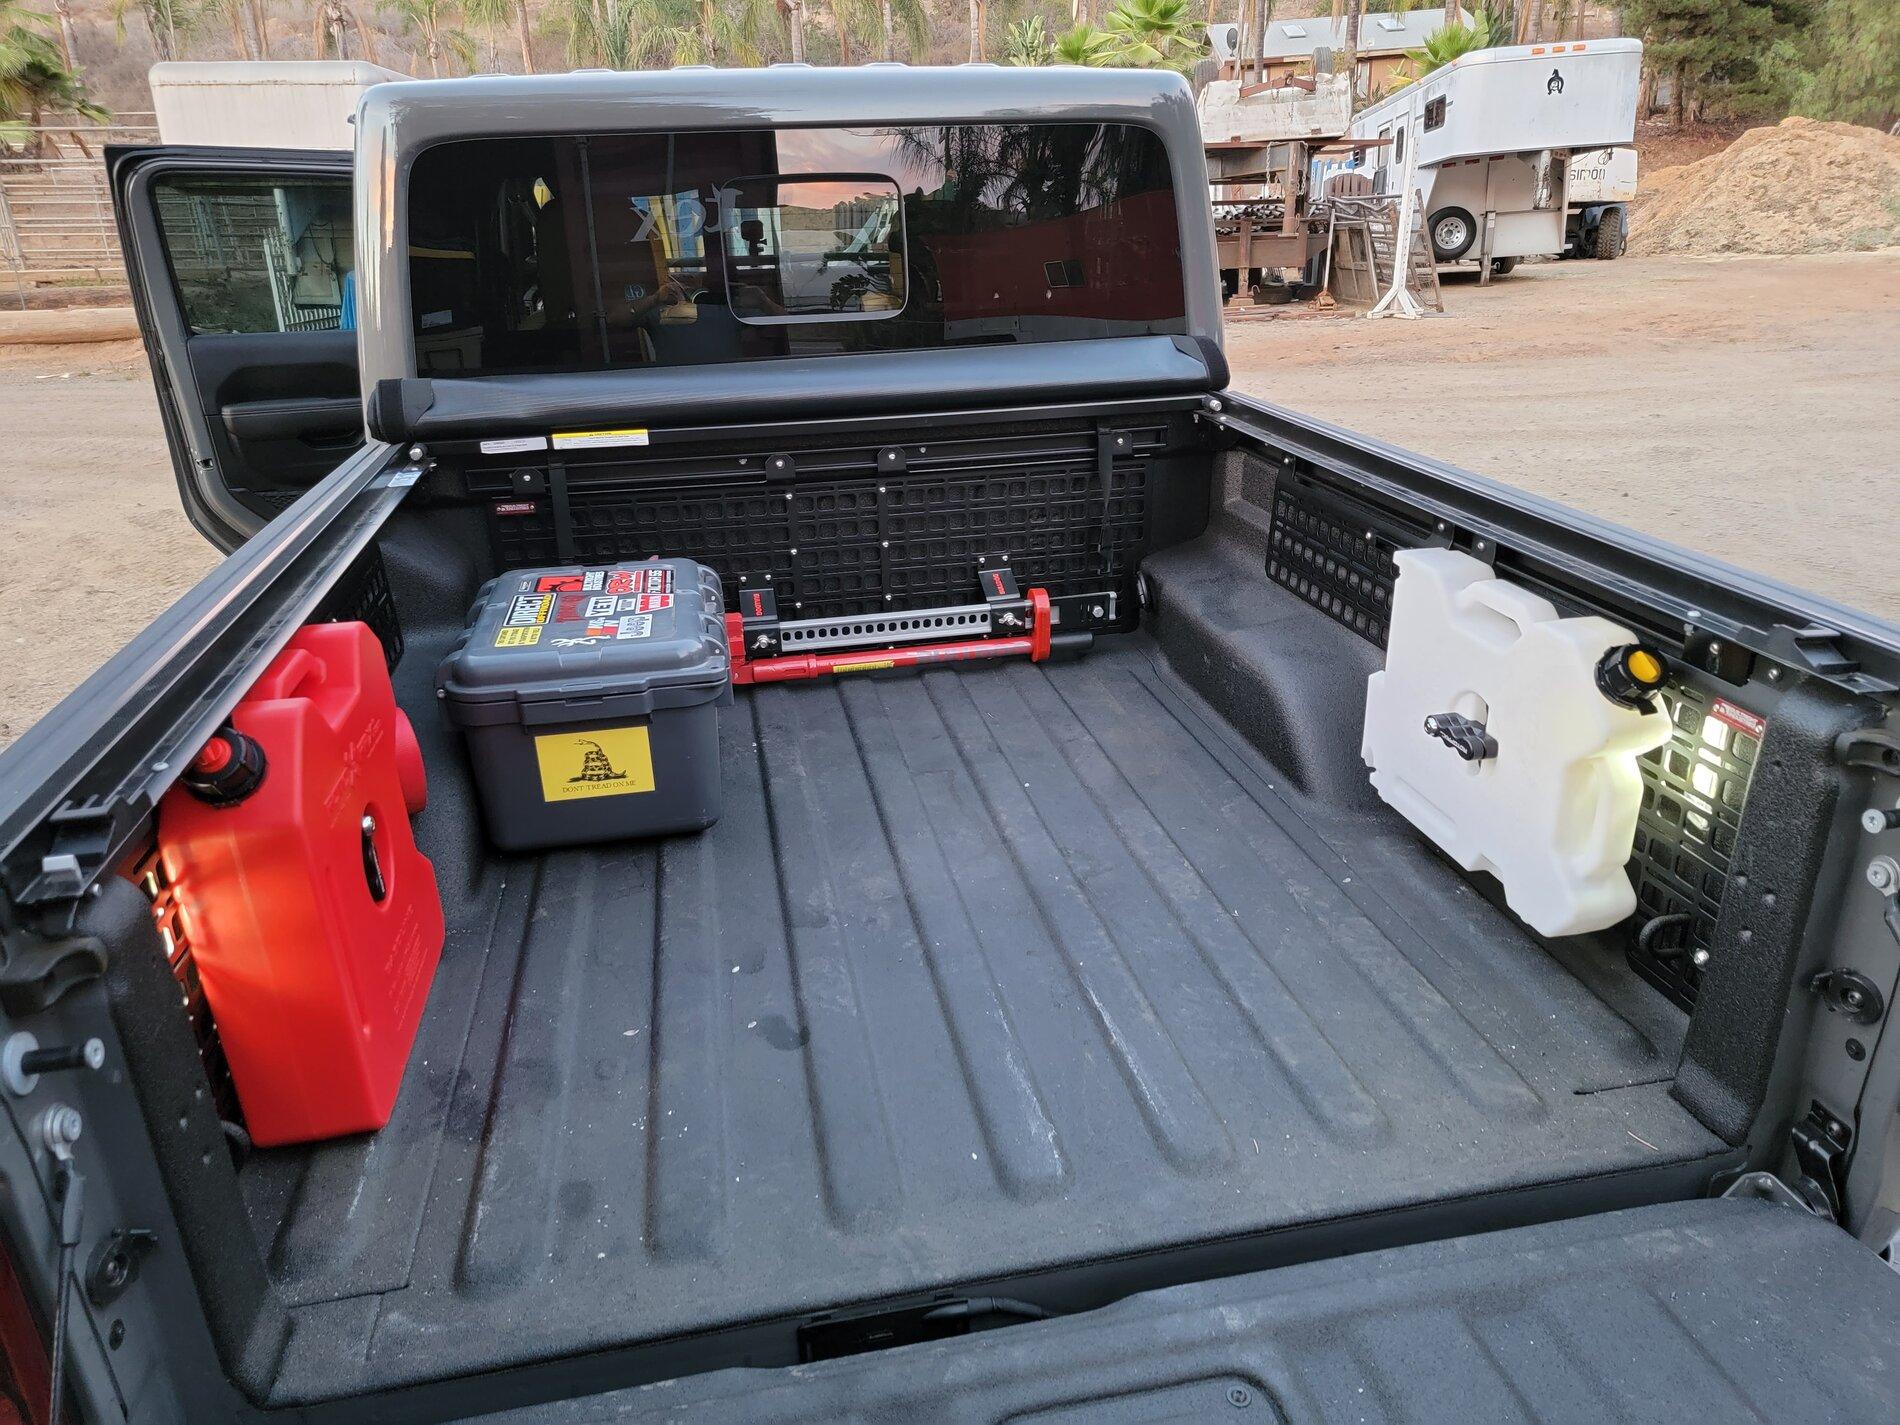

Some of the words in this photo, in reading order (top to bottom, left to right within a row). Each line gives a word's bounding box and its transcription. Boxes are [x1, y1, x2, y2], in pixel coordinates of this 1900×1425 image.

[510, 596, 543, 625] DIRECT
[537, 594, 551, 623] OFFROAD
[591, 597, 613, 615] YETI
[619, 616, 650, 636] Jeep
[586, 782, 612, 790] TREAD
